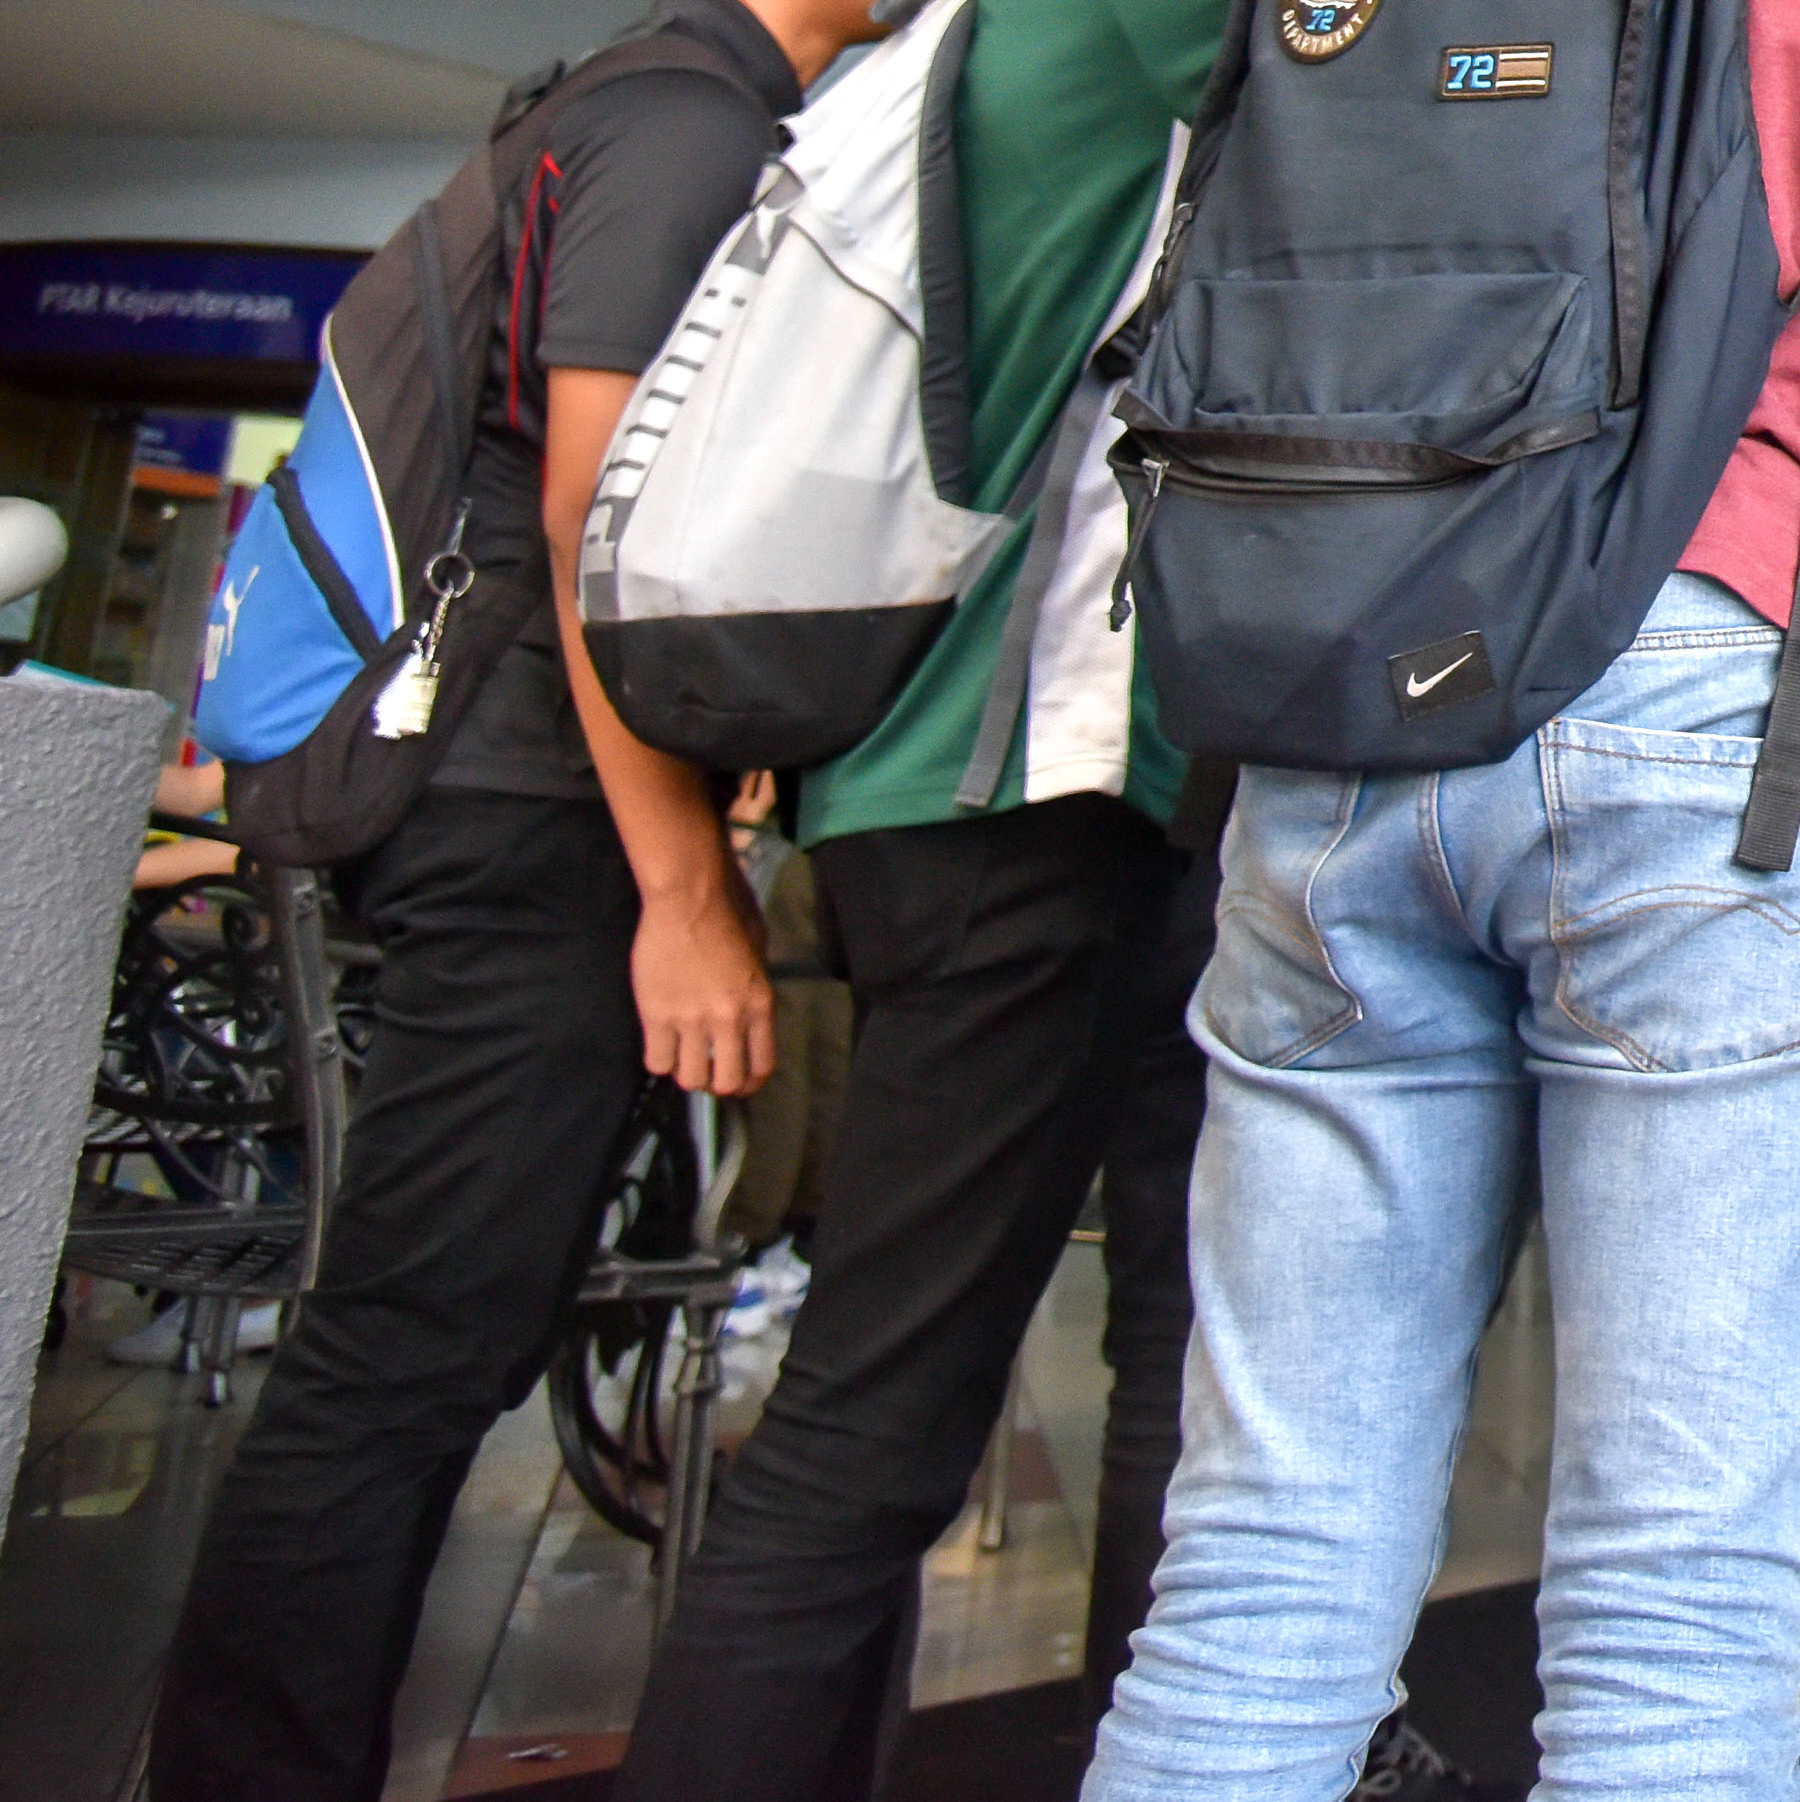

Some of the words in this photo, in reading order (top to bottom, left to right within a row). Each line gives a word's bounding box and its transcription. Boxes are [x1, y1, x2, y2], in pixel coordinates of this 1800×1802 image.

[1304, 7, 1337, 33] 72
[1446, 53, 1496, 90] 72
[40, 282, 101, 315] PTAR
